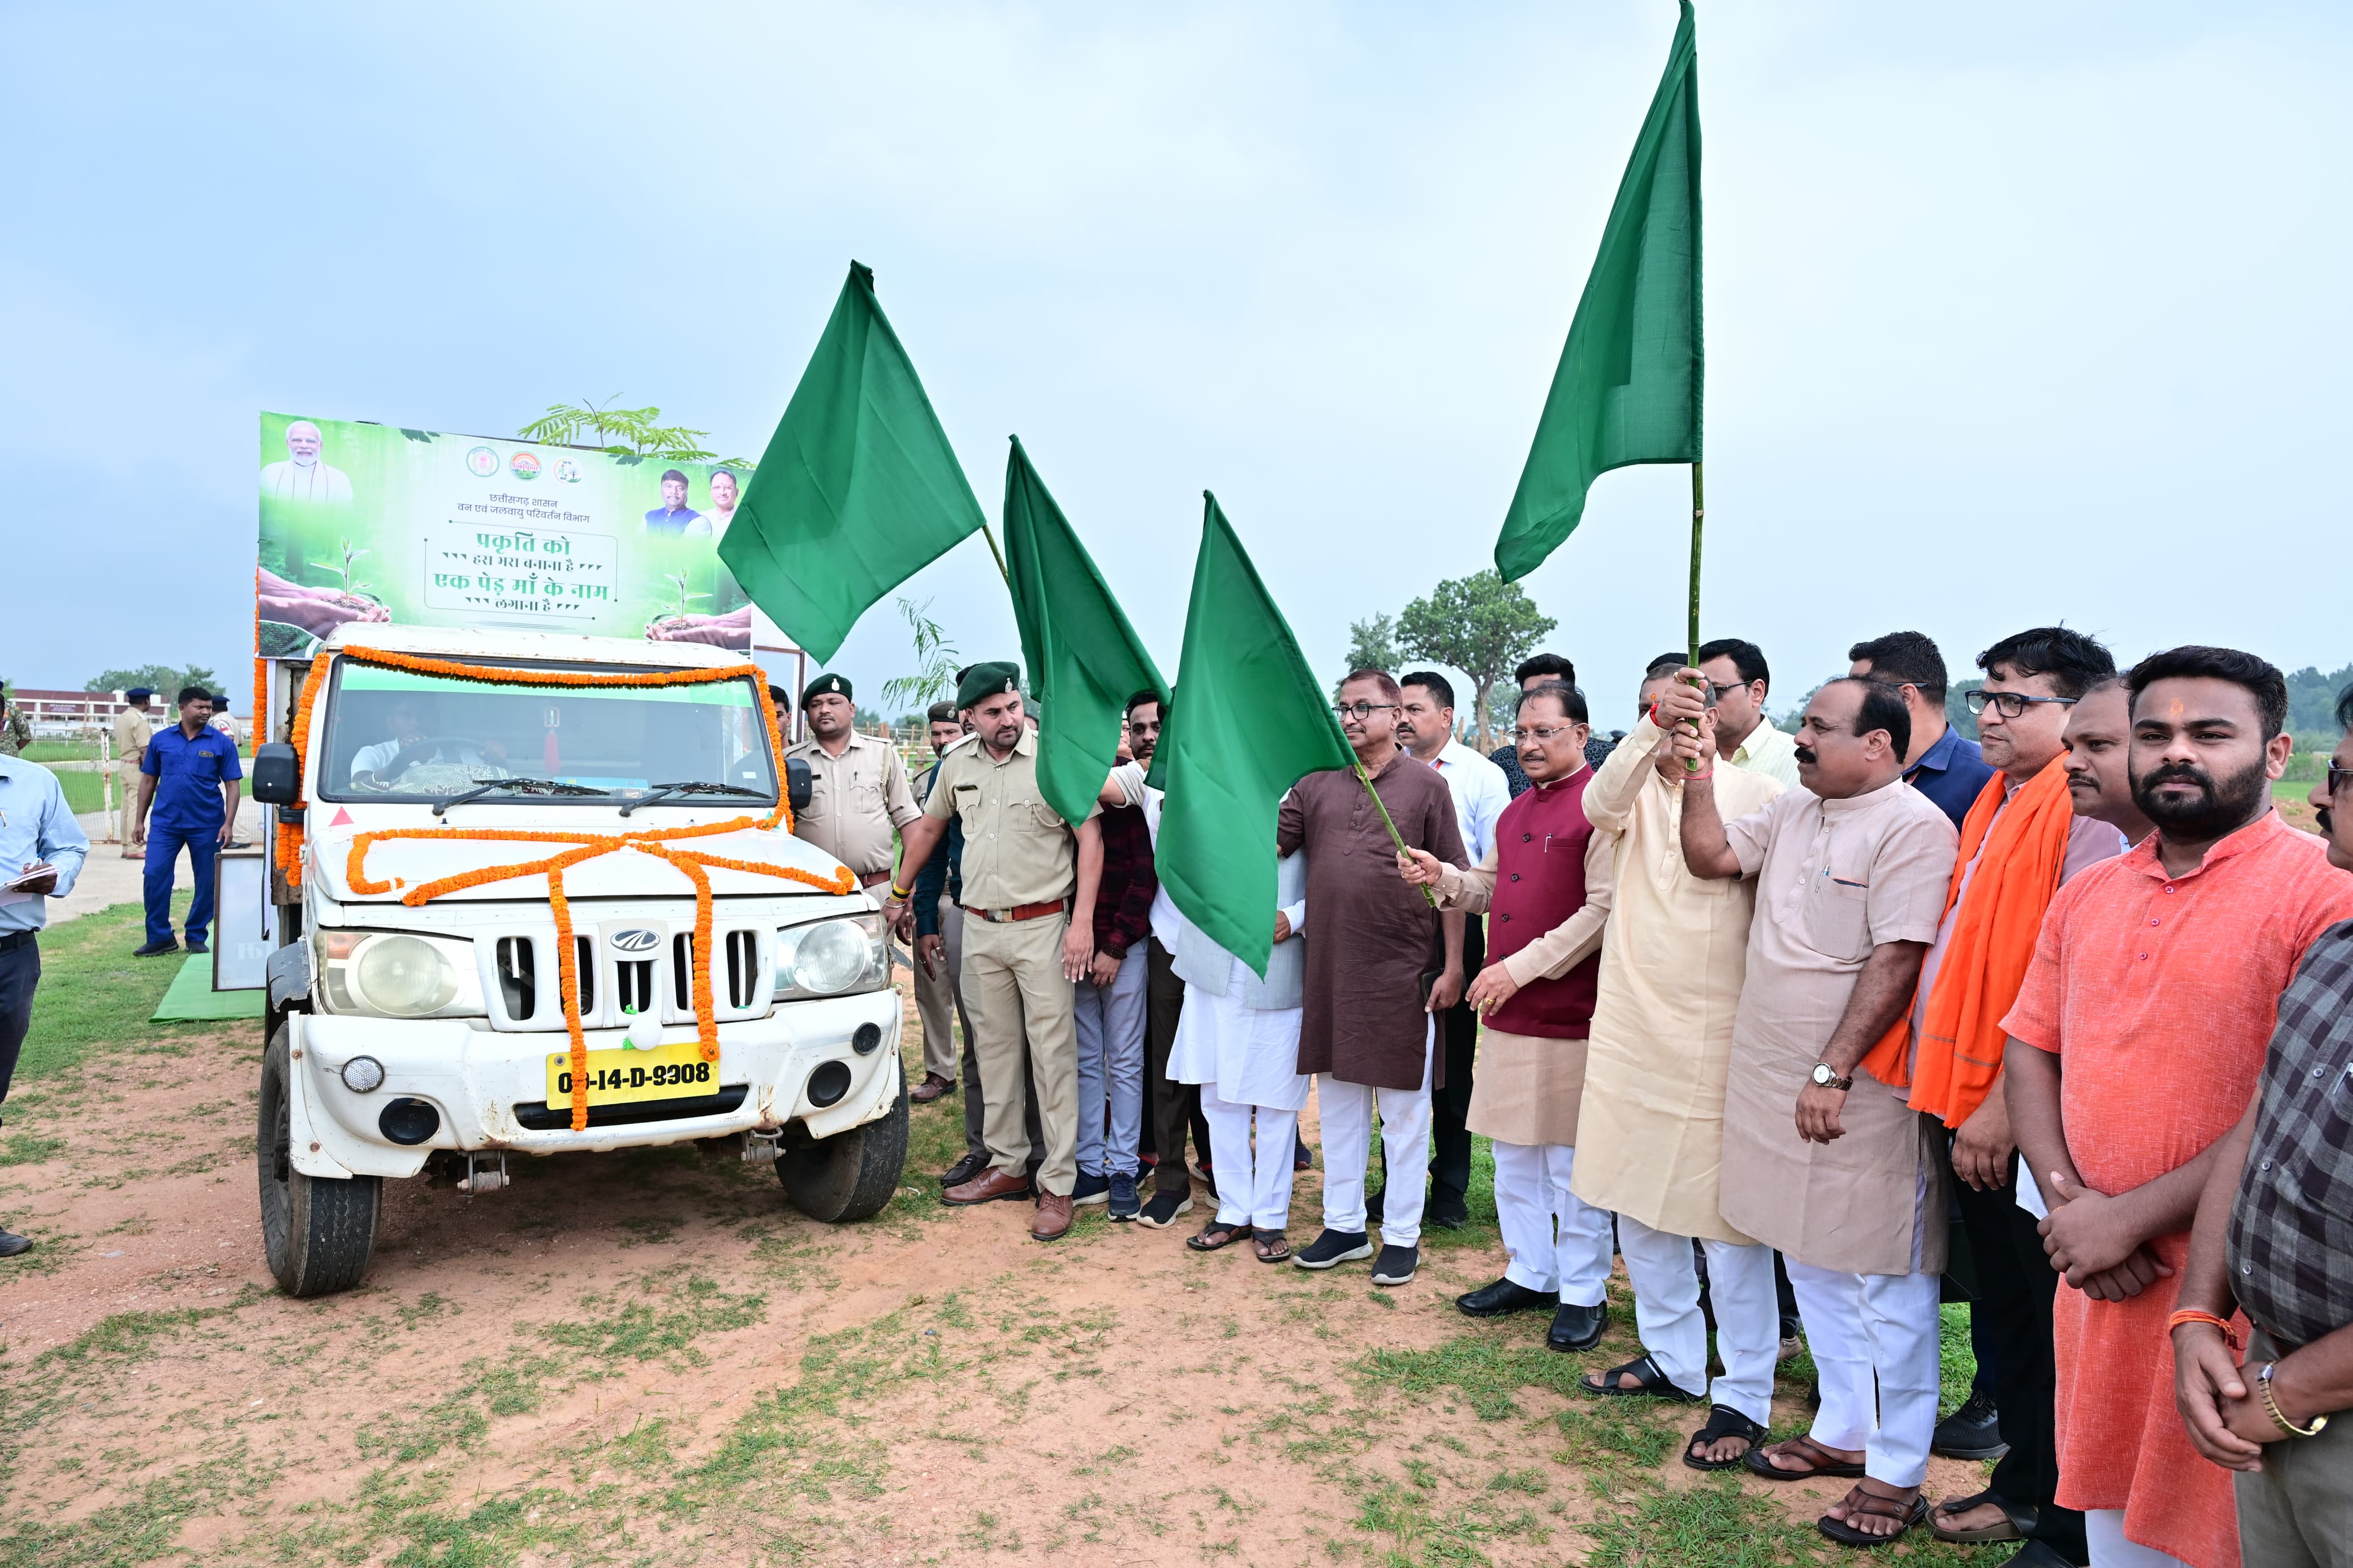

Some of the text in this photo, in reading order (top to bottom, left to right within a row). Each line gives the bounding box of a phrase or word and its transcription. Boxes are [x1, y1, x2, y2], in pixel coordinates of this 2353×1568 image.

[489, 493, 558, 508] छत्तीसगढ़ शासन
[457, 503, 590, 523] वन एवं जलवायु परिवर्तन विभाग
[475, 532, 572, 555] प्रकृति को
[472, 554, 574, 572] हरा भरा बनाना है
[432, 571, 610, 600] एक पेड़ माँ के नाम
[494, 598, 551, 612] लगाना है
[558, 1062, 710, 1094] O-14-D-9908
